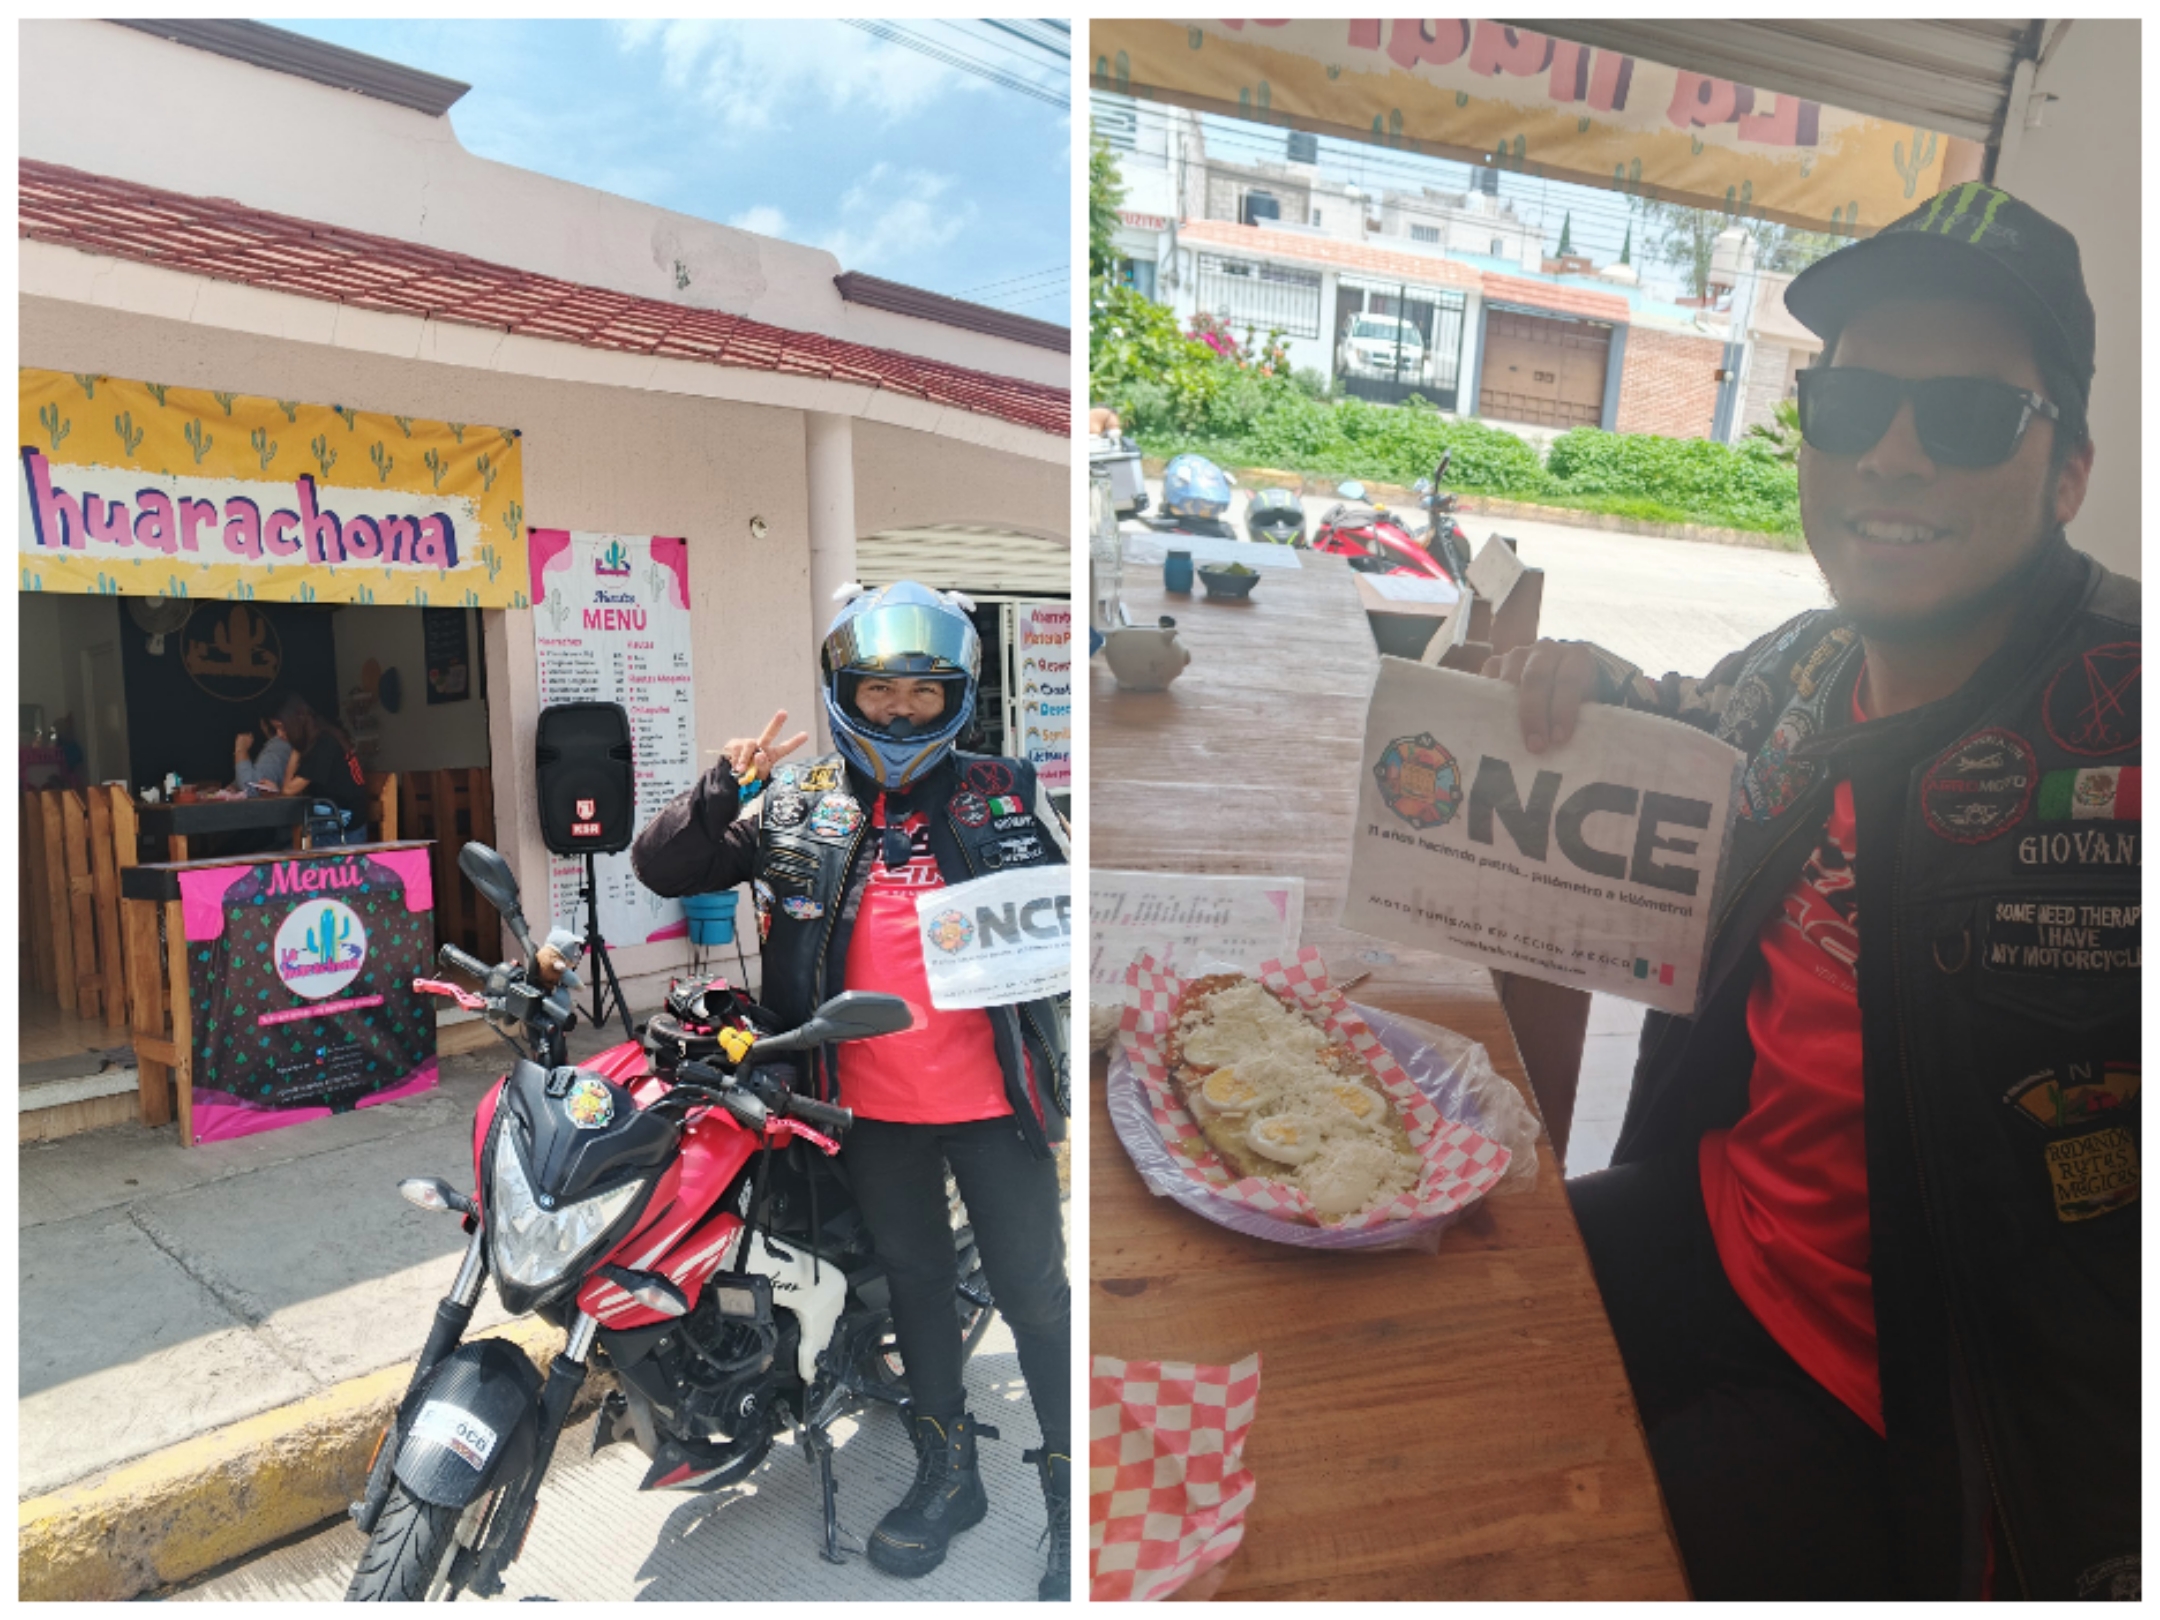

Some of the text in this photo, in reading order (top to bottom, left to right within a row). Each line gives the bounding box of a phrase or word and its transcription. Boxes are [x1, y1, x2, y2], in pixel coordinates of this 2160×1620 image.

[20, 446, 460, 569] huarachona
[582, 603, 648, 631] MENÚ
[1419, 837, 1475, 864] haciendo
[2018, 829, 2142, 866] GIOVAN
[266, 855, 363, 896] Menú
[1996, 902, 2142, 928] SOME NEED THERAP
[2037, 925, 2100, 949] I HAVE
[1991, 942, 2019, 965] MY
